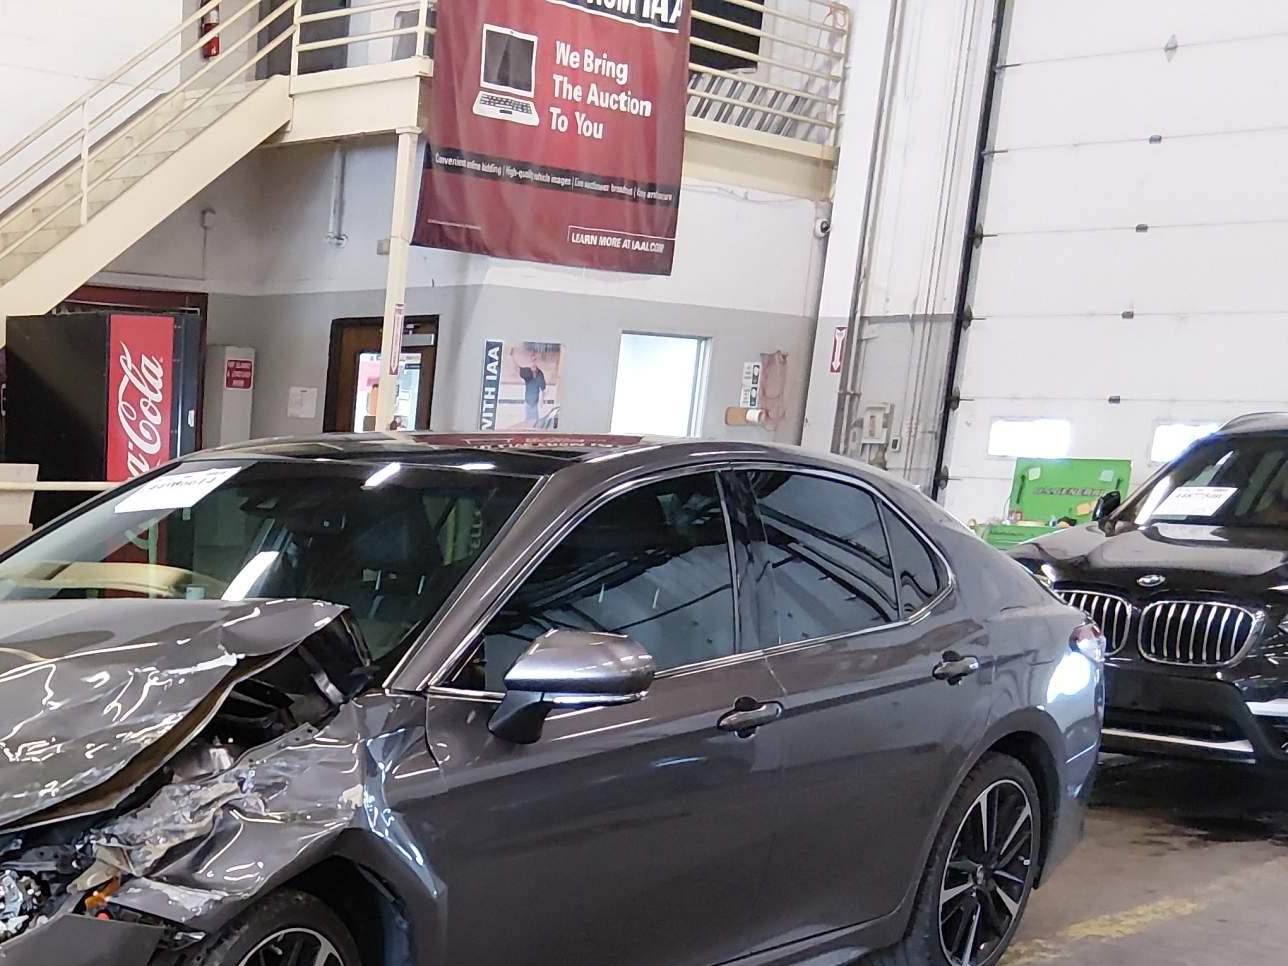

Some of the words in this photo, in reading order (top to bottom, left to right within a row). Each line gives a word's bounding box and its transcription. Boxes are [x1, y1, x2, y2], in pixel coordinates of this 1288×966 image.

[555, 40, 580, 69] We
[583, 48, 629, 85] Bring
[552, 73, 583, 102] The
[586, 82, 652, 117] Auction
[549, 106, 569, 132] To
[574, 111, 604, 139] You
[571, 232, 598, 245] LEARN
[598, 236, 622, 248] MORE
[621, 239, 632, 250] AT
[485, 345, 501, 381] IAA
